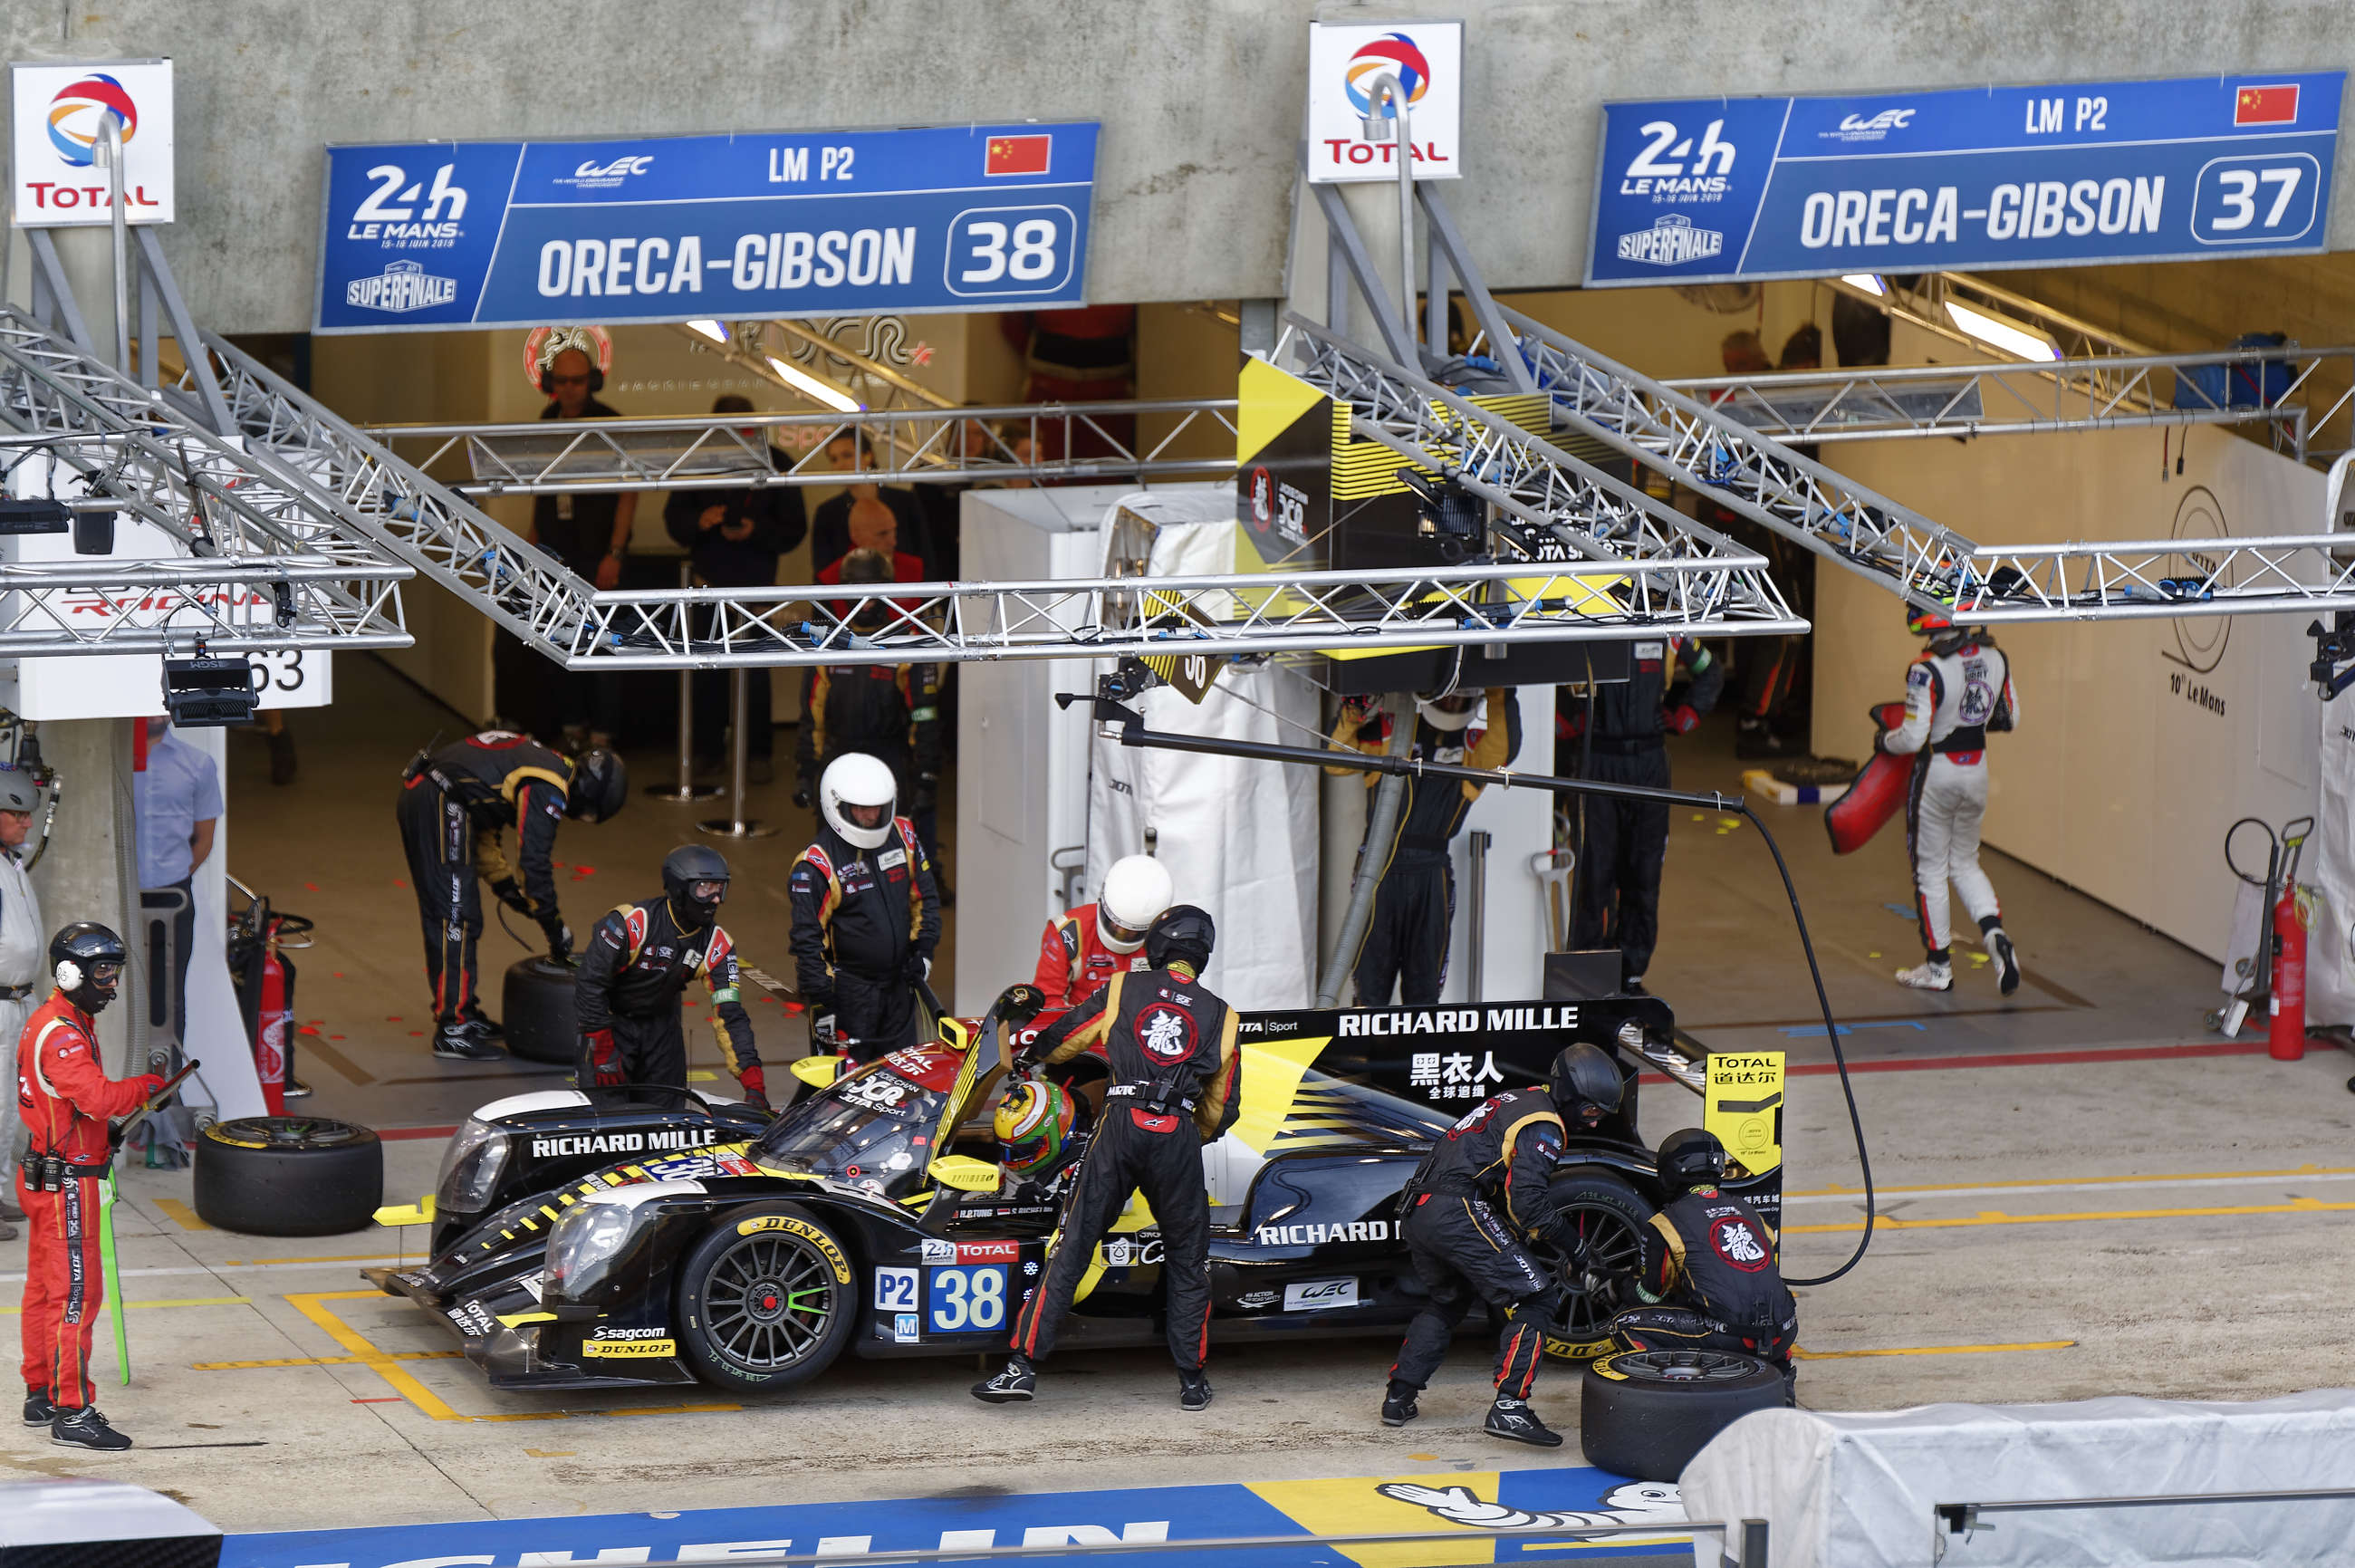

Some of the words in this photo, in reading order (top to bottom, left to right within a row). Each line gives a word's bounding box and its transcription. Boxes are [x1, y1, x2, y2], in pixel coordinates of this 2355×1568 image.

[2025, 98, 2064, 134] LM
[2075, 97, 2108, 130] P2
[1324, 139, 1449, 164] TOTAL
[1626, 119, 1736, 177] 24h
[769, 147, 810, 182] LM
[821, 146, 855, 180] P2
[352, 163, 468, 221] 24h
[1620, 178, 1652, 195] LE
[1655, 177, 1727, 194] MANS
[1800, 175, 2166, 248] ORECA-GIBSON
[2212, 167, 2302, 230] 37
[347, 224, 381, 239] LE
[383, 223, 457, 239] MANS
[1620, 226, 1722, 265] SUPERFINALE
[537, 226, 917, 298] ORECA-GIBSON
[961, 218, 1057, 283] 38
[349, 271, 455, 310] SUPERFINALE
[1269, 1021, 1298, 1034] Sport
[1339, 1010, 1479, 1037] RICHARD
[1486, 1006, 1579, 1033] MILLE
[1409, 1051, 1504, 1086] 黑衣人
[1714, 1072, 1776, 1084] 道达尔
[1715, 1056, 1776, 1069] TOTAL
[872, 1101, 907, 1117] Sport
[533, 1133, 644, 1158] RICHARD
[649, 1129, 716, 1150] MILLE
[763, 1217, 848, 1274] DUNLOP
[1260, 1221, 1388, 1246] RICHARD
[959, 1244, 1015, 1256] TOTAL
[72, 1250, 82, 1282] JOTA
[880, 1274, 914, 1305] P2
[933, 1268, 1004, 1330] 38
[1301, 1282, 1352, 1299] WEC
[464, 1299, 495, 1334] TOTAL
[898, 1319, 916, 1334] M
[600, 1343, 672, 1354] DUNLOP
[608, 1327, 666, 1341] sagcom
